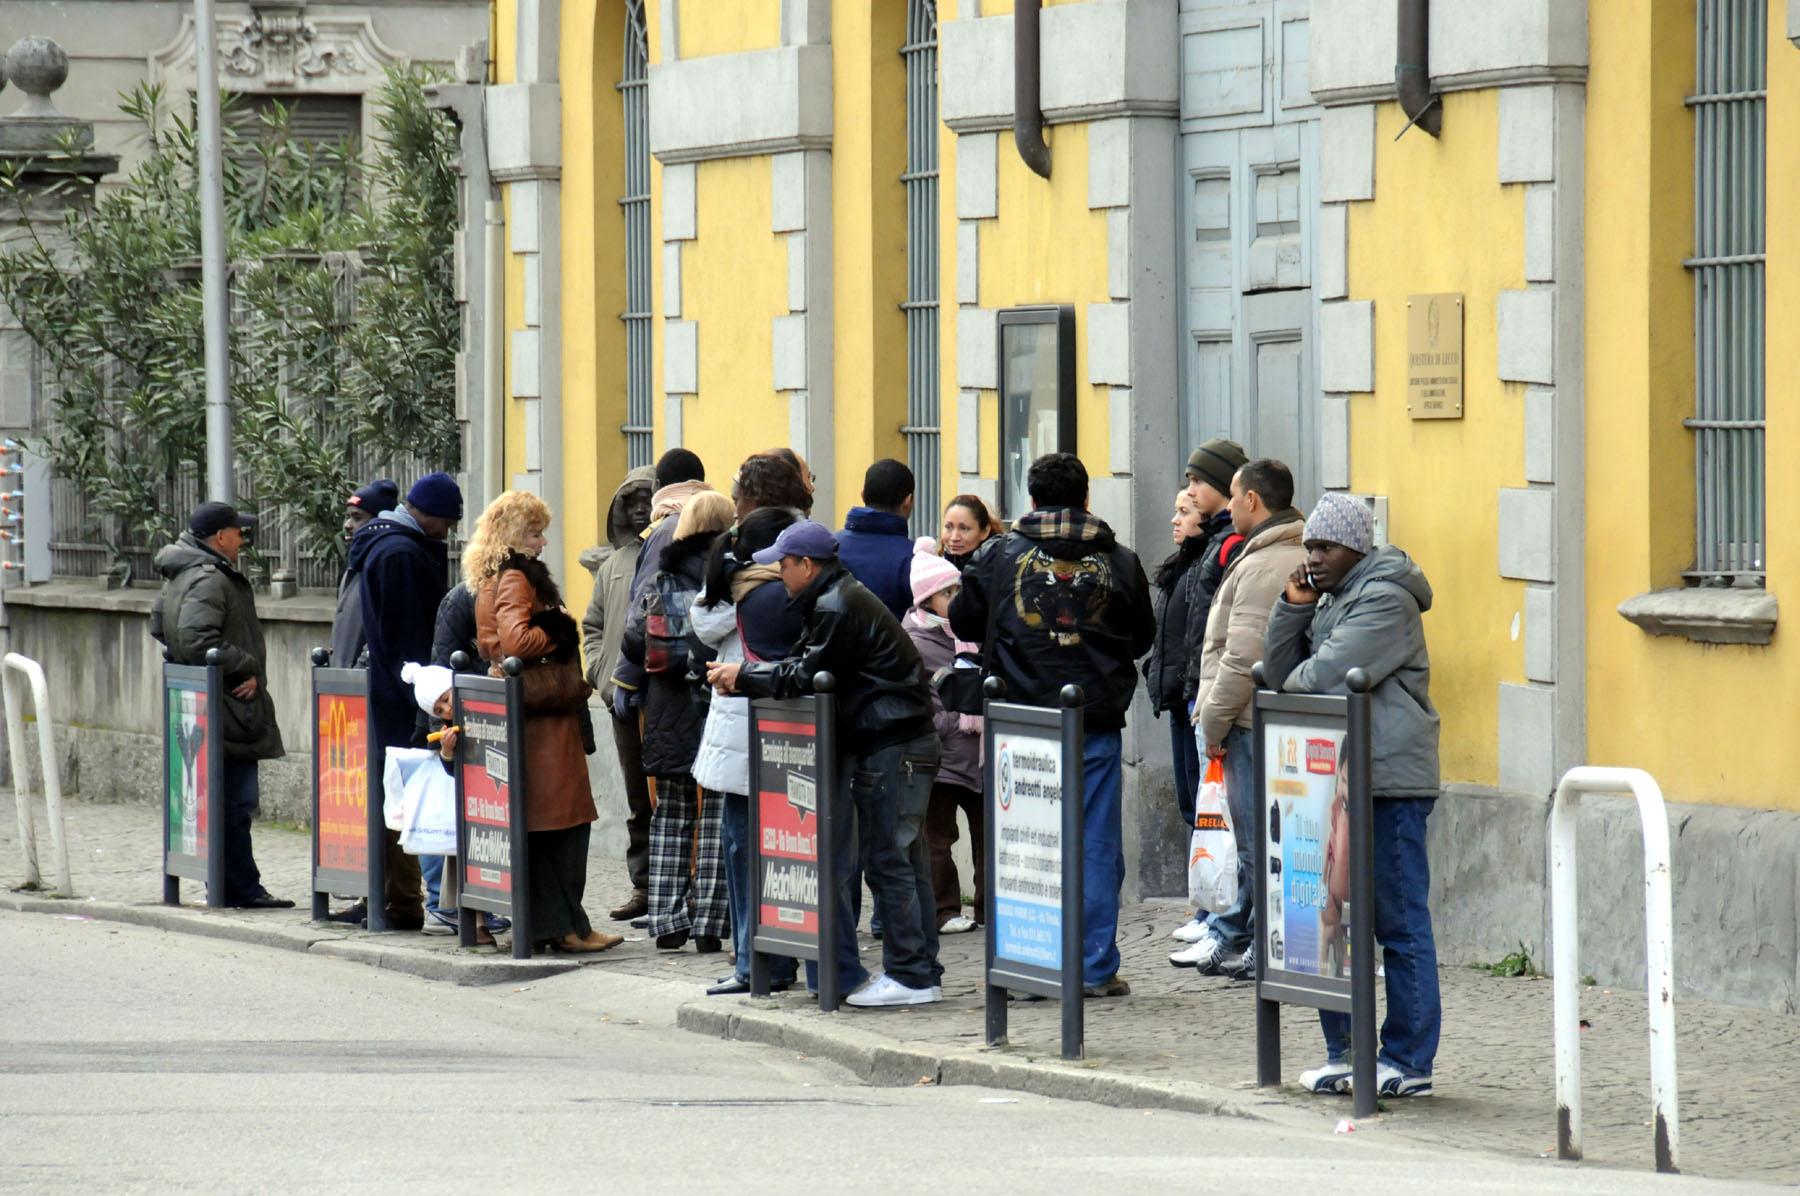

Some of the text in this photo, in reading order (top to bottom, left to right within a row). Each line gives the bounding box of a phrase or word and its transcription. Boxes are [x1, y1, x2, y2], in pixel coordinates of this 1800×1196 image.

[1012, 751, 1056, 774] termoidraulica
[1293, 849, 1323, 876] mondo
[1291, 879, 1328, 910] digitale
